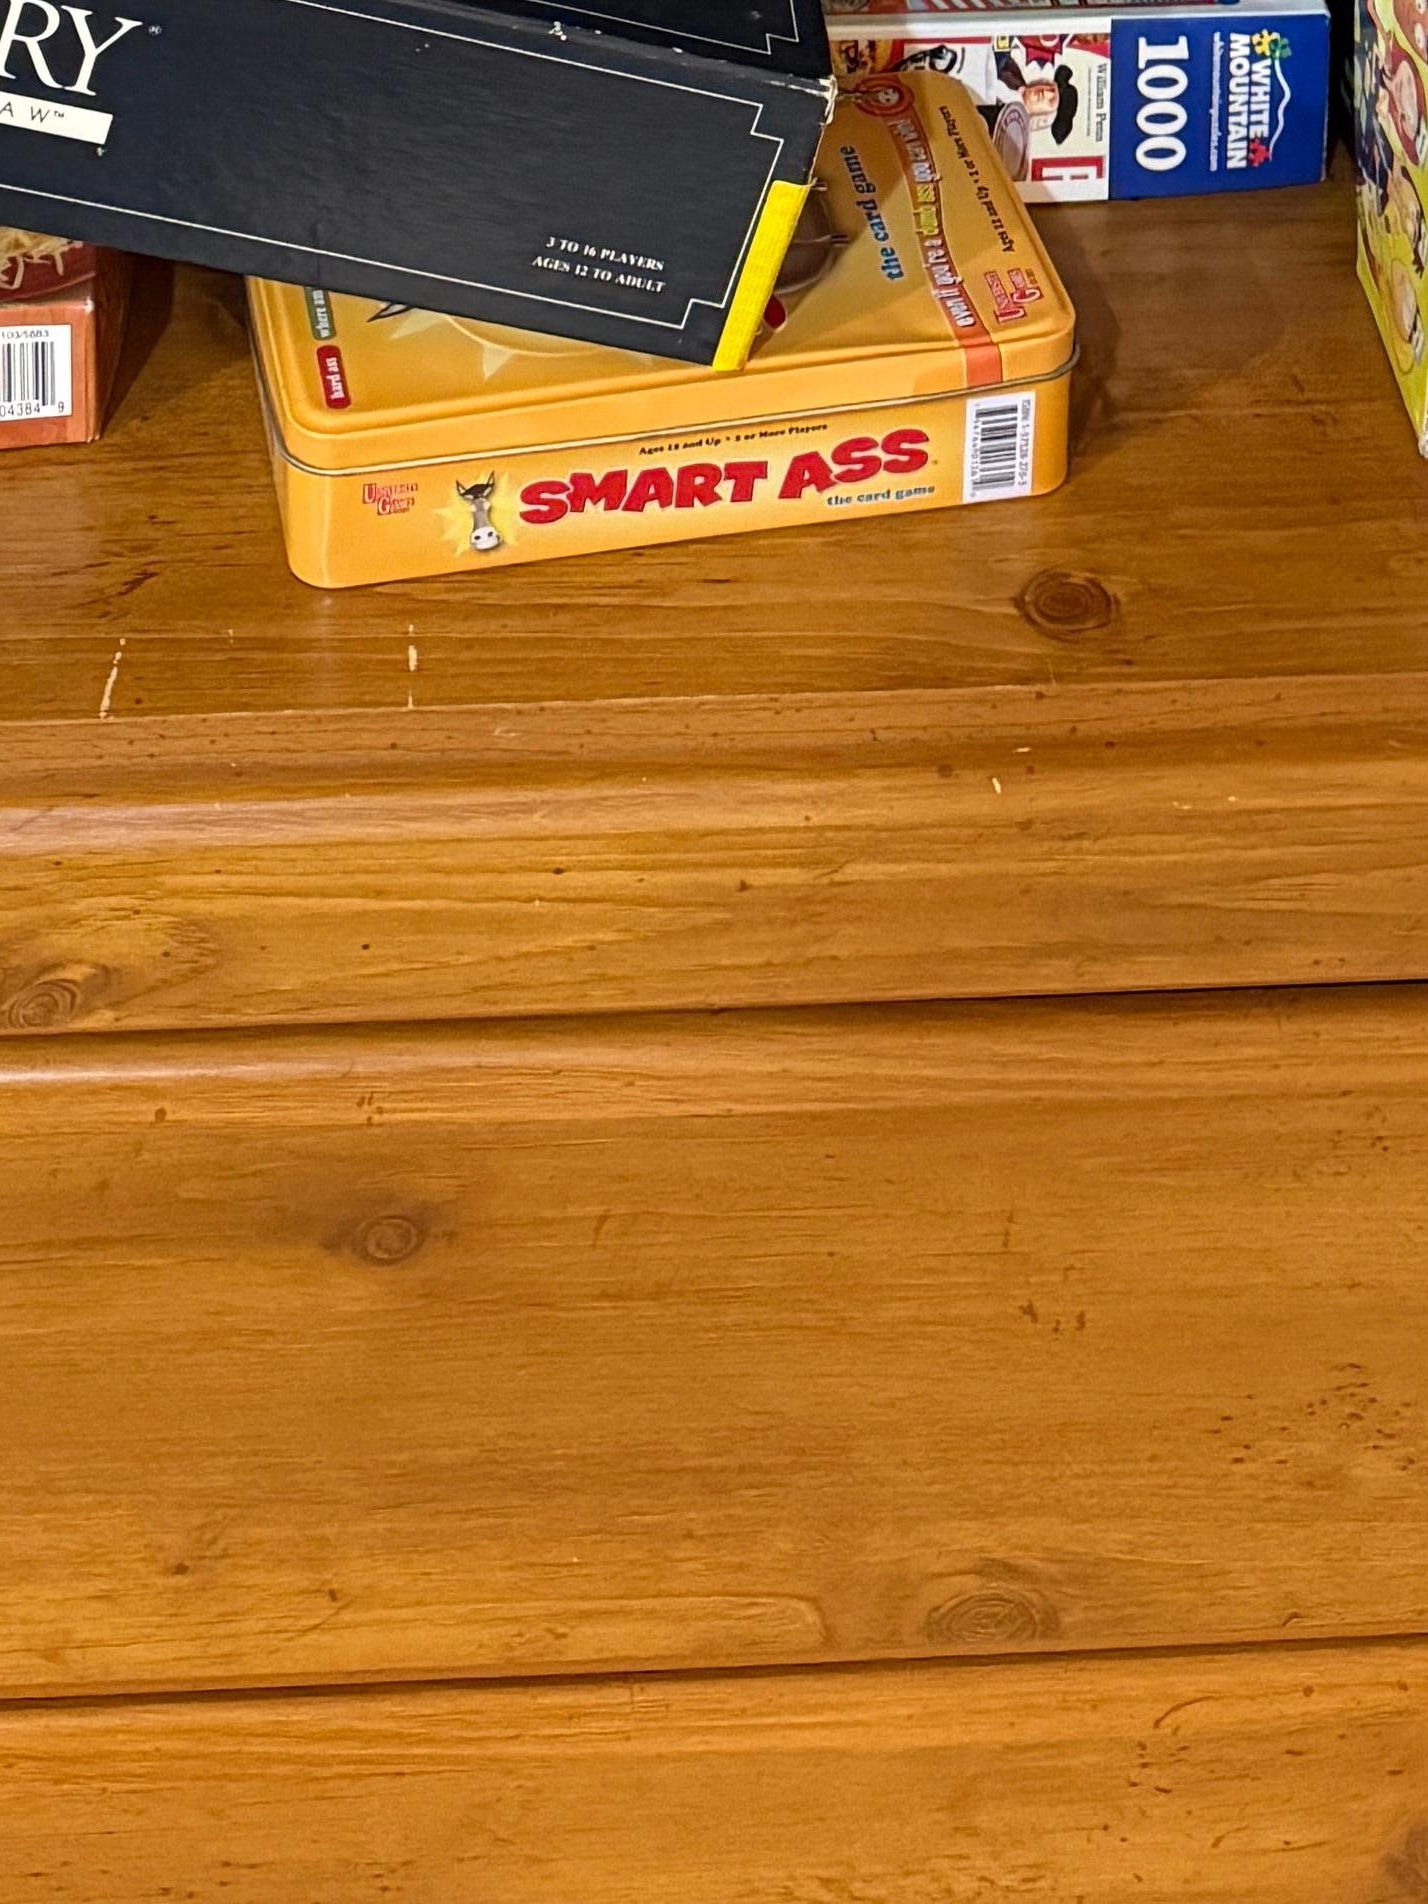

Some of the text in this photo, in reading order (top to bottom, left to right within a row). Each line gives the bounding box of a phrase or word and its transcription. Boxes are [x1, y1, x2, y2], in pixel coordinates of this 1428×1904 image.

[1135, 36, 1189, 171] 1000
[1227, 32, 1250, 169] MOUNTAIN
[1248, 57, 1271, 139] WHITE
[519, 426, 931, 526] SMART ASS
